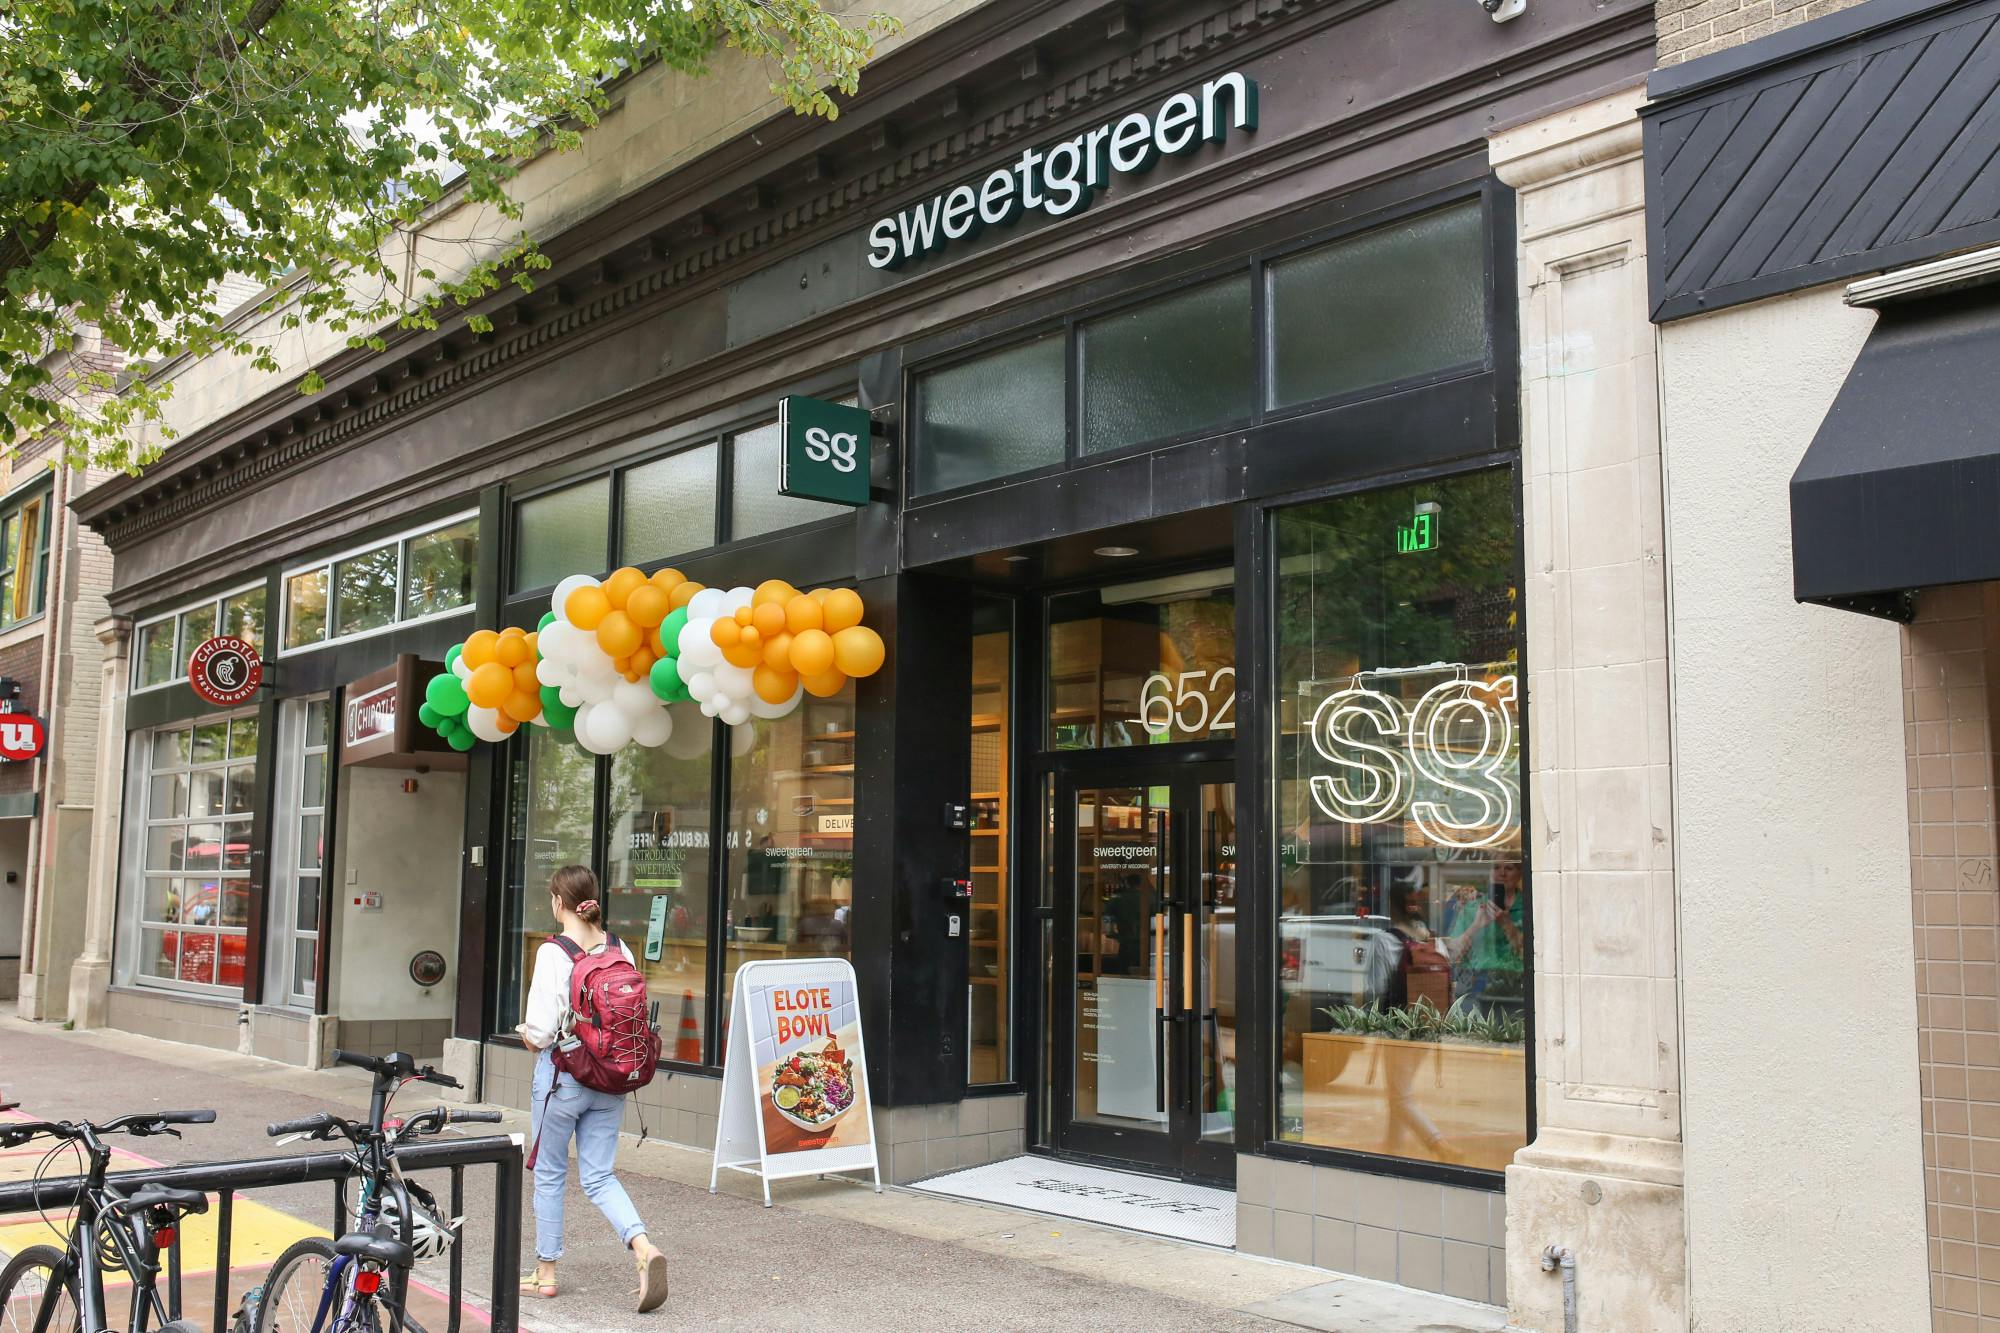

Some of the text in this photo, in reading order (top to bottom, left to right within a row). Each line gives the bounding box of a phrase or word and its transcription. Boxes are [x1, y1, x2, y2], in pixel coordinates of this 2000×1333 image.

[866, 71, 1250, 269] sweetgreen
[804, 427, 858, 473] sg
[197, 638, 260, 668] CHIPOTLE
[197, 674, 257, 701] MEXICAN GRILL
[1140, 667, 1236, 735] 652
[1310, 675, 1518, 849] sg
[632, 849, 686, 861] INTRODUCING
[765, 846, 813, 859] sweetgreen
[1093, 846, 1157, 860] sweetgreen
[635, 863, 681, 875] SWEETPASS
[773, 987, 832, 1011] ELOTE
[777, 1013, 837, 1045] BOWL
